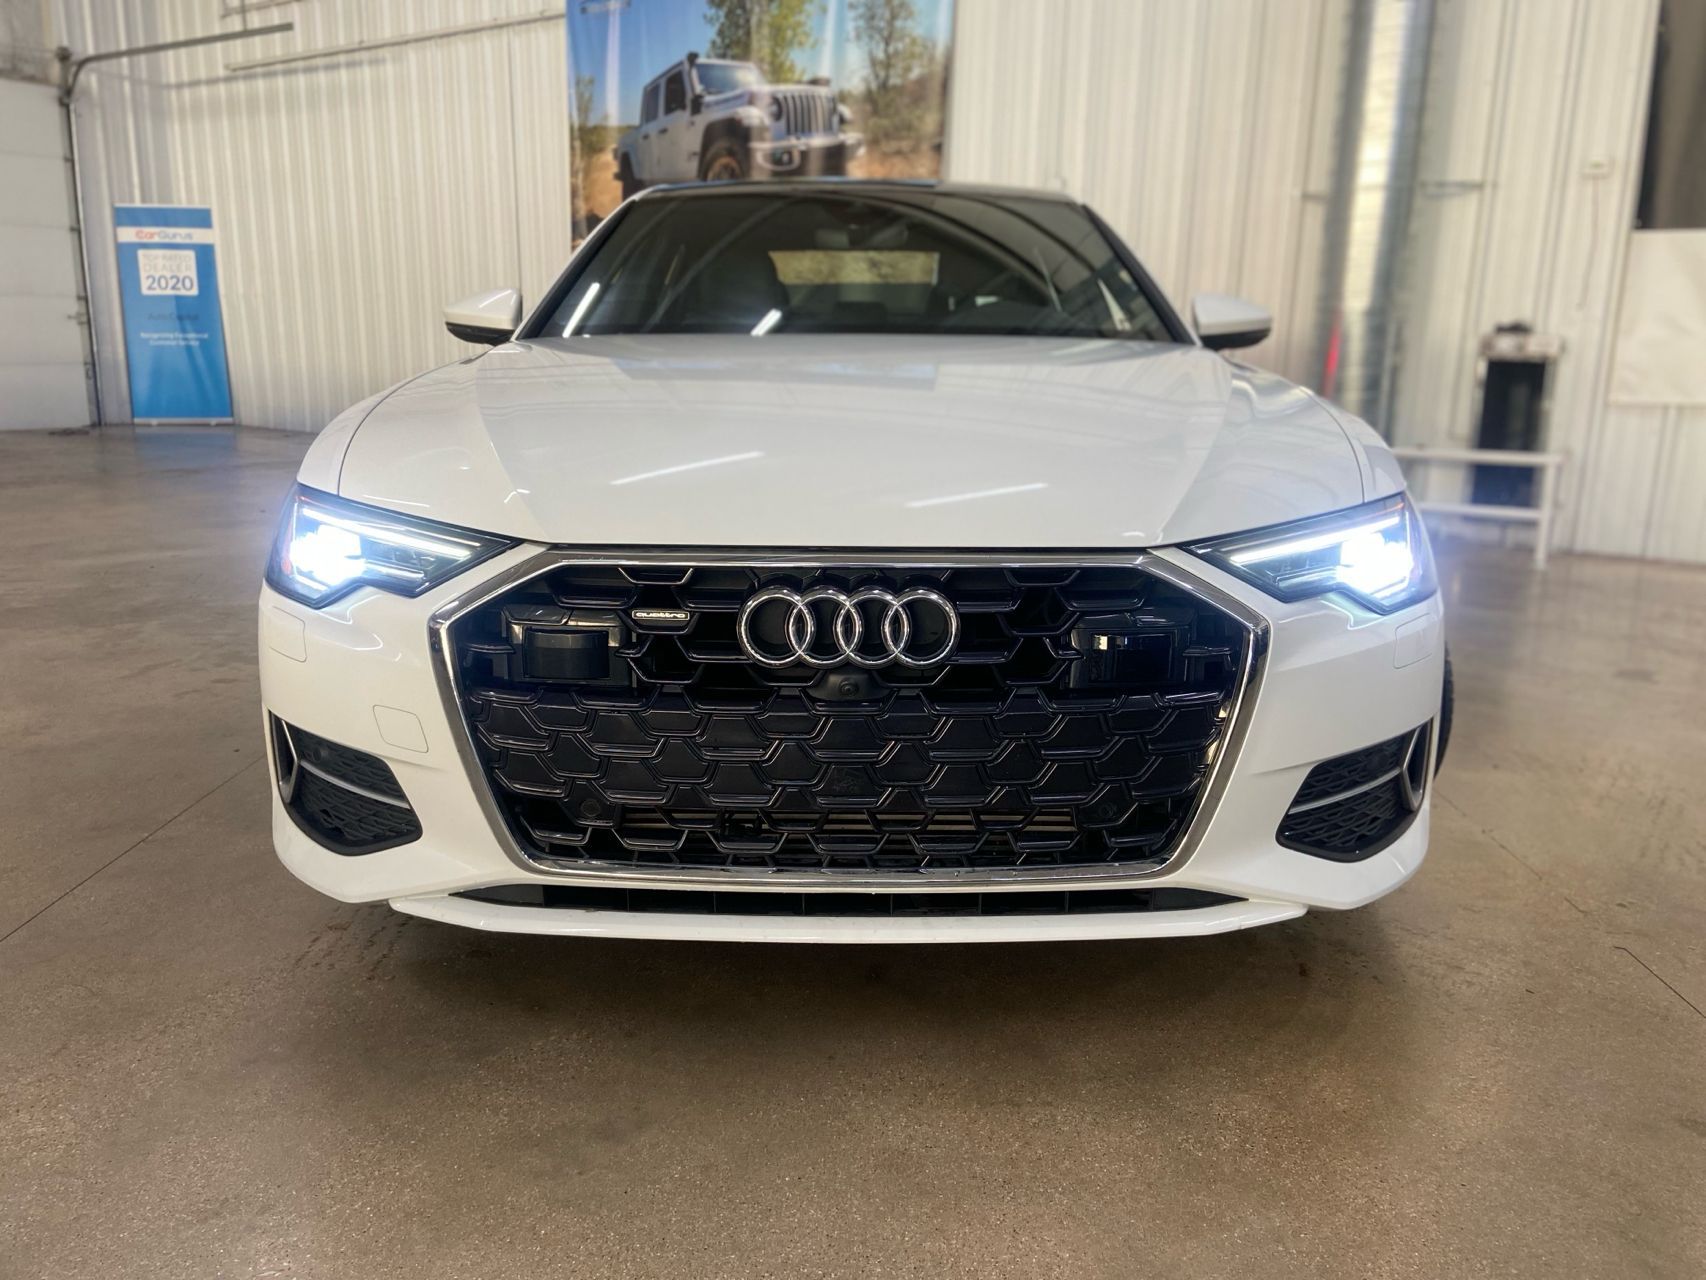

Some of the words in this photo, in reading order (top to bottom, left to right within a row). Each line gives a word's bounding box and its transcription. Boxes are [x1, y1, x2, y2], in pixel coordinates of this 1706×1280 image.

[135, 229, 193, 241] CarGurus
[143, 263, 192, 273] DEALER
[145, 274, 194, 291] 2020
